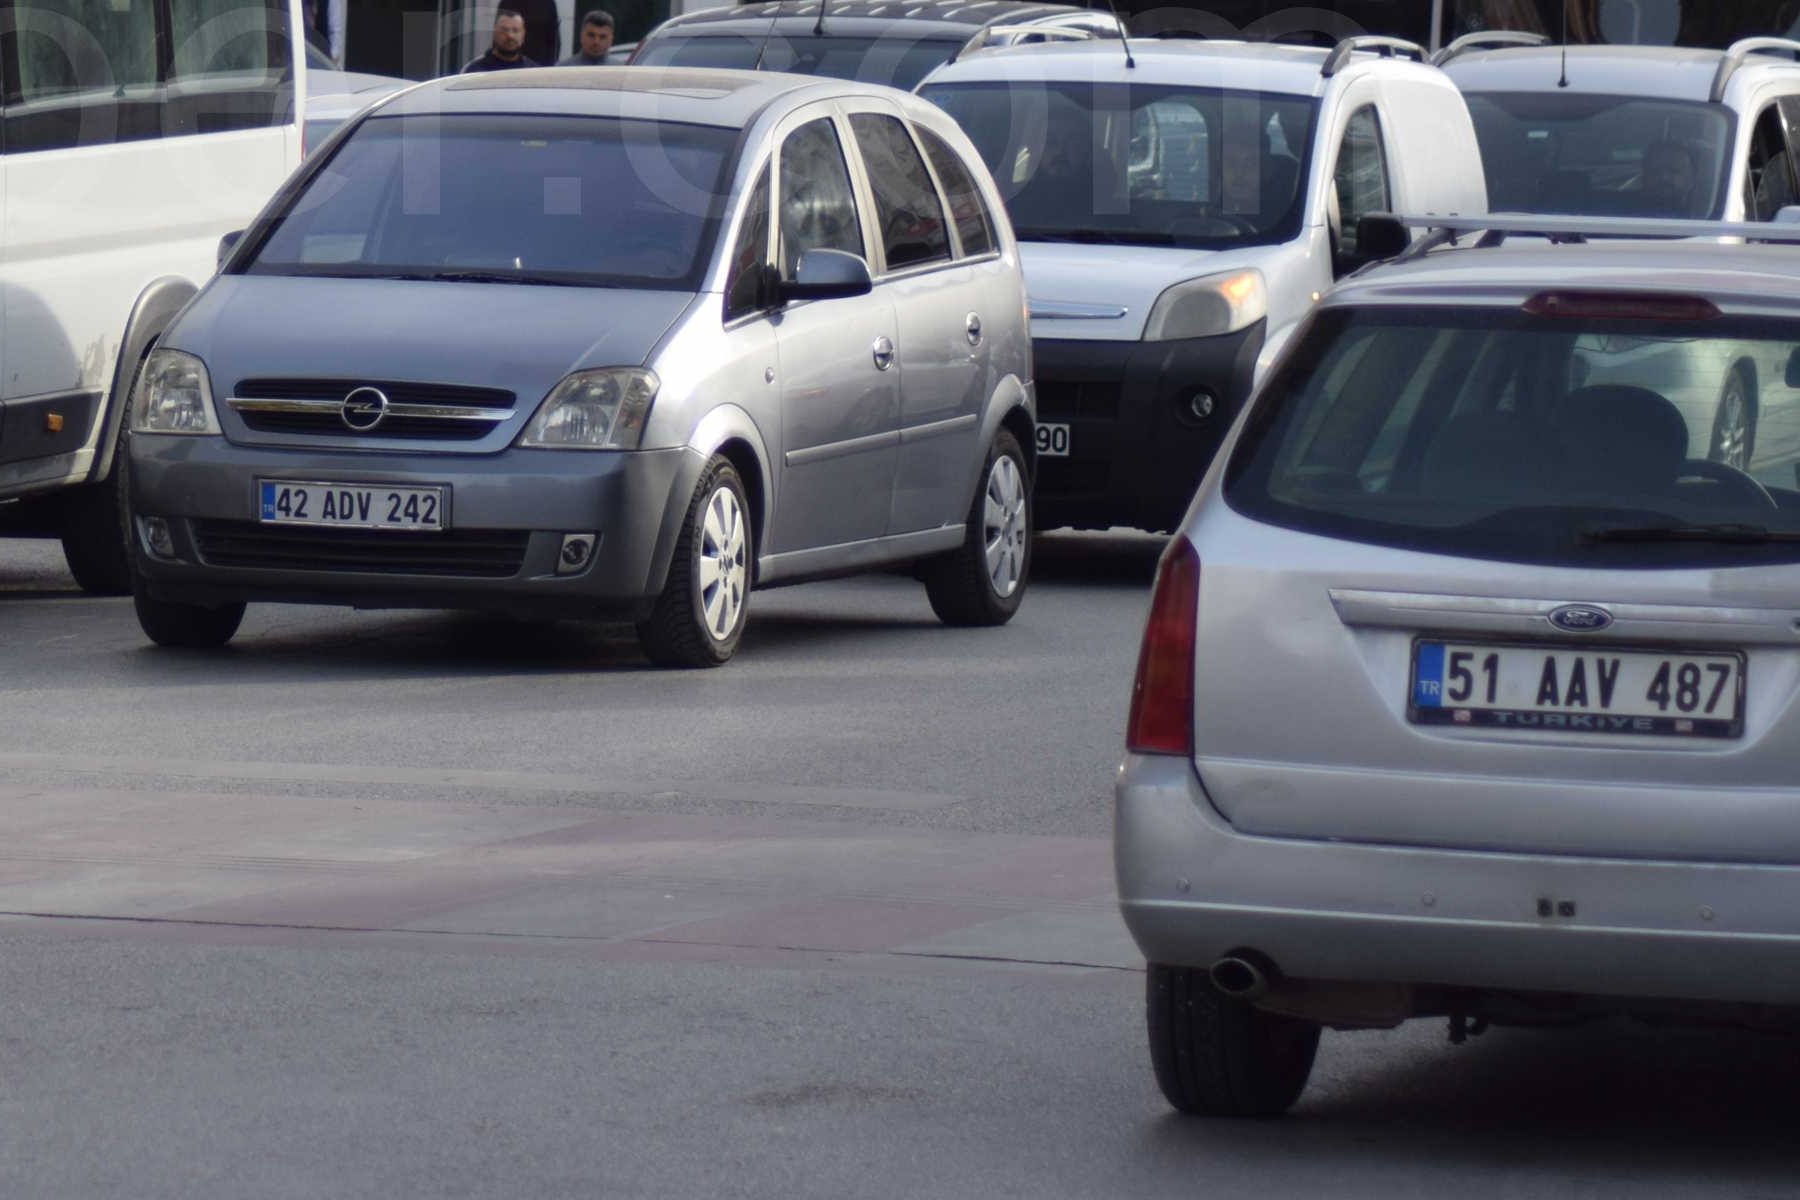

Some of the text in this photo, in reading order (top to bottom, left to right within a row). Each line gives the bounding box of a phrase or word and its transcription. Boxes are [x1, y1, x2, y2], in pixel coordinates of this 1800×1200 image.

[276, 487, 308, 519] 42
[322, 490, 372, 522] ADV
[386, 492, 437, 524] 242
[1419, 651, 1731, 714] TR 51 AAV 487
